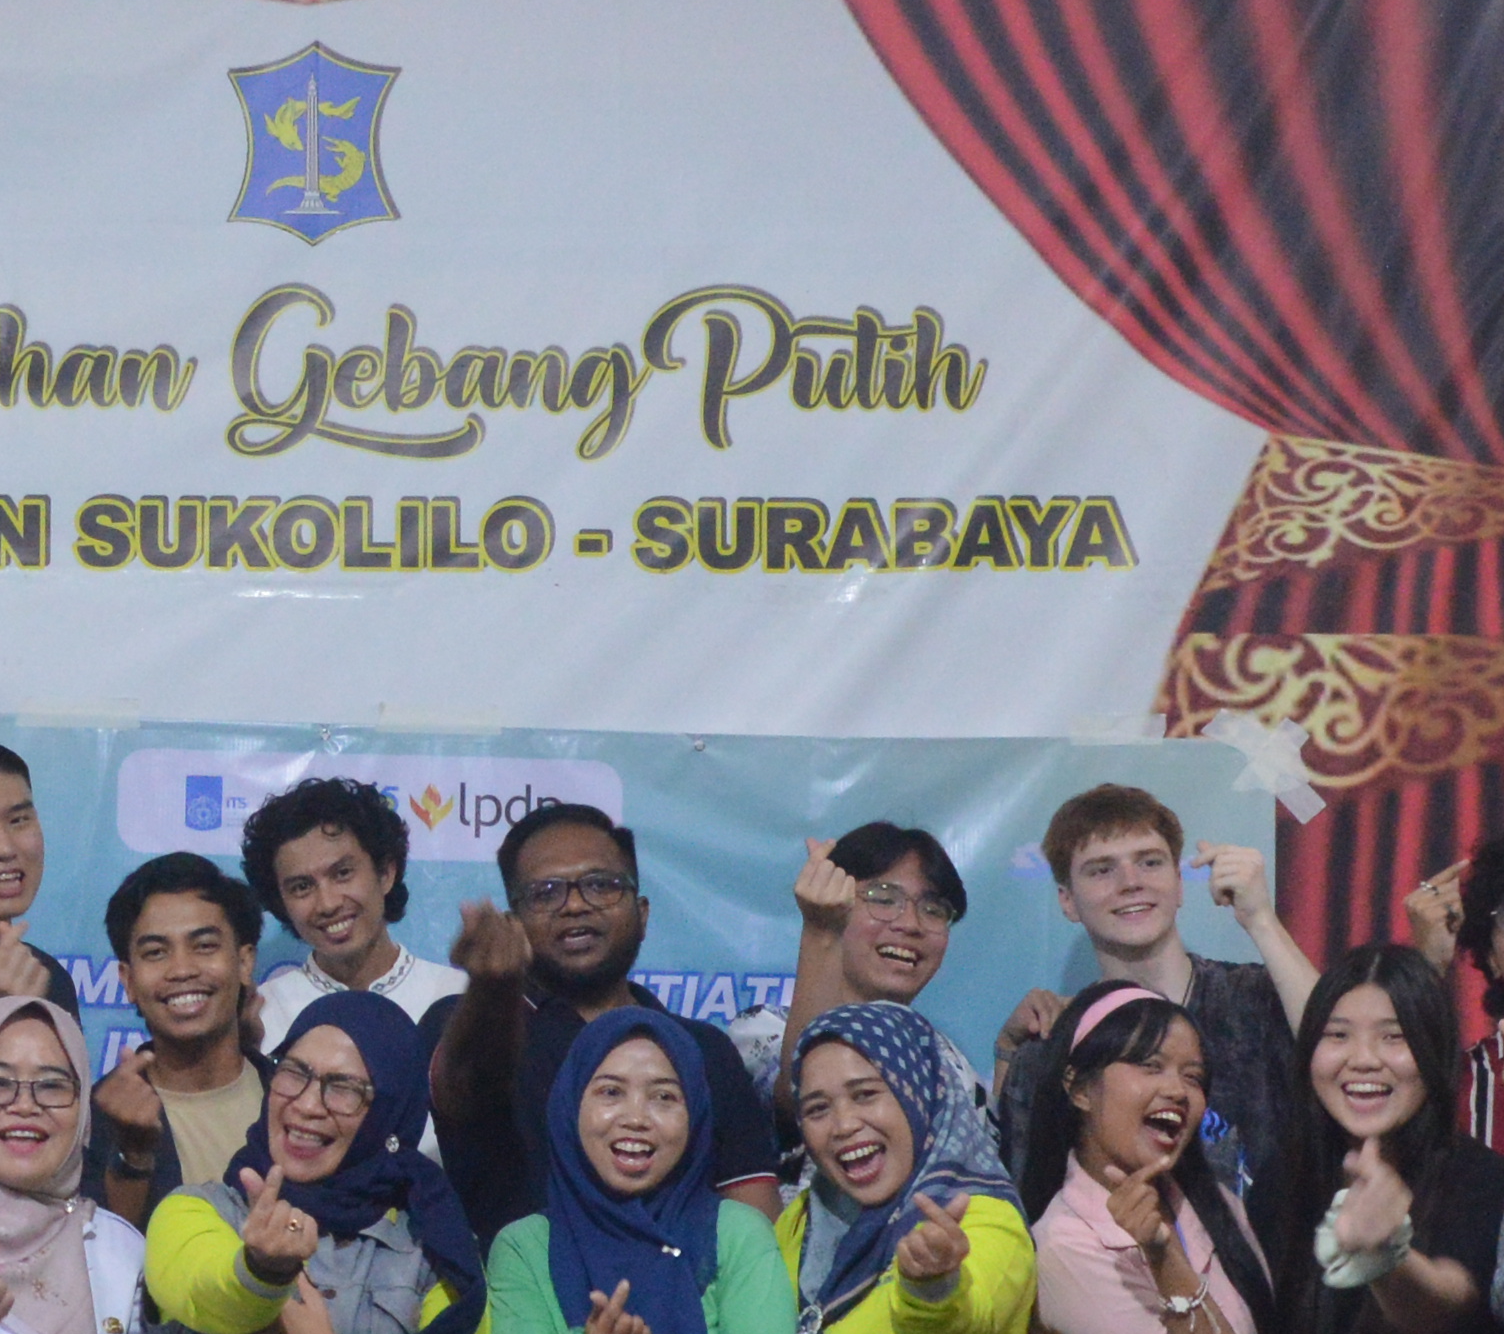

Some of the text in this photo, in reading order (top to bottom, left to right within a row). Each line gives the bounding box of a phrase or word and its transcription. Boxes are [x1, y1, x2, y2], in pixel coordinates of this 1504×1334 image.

[224, 283, 648, 461] Gebang
[643, 283, 989, 450] Putih
[72, 493, 556, 572] SUKOLILO
[574, 527, 613, 558] -
[630, 495, 1140, 574] SURABAYA
[225, 796, 248, 809] ITS
[459, 782, 565, 838] lpd
